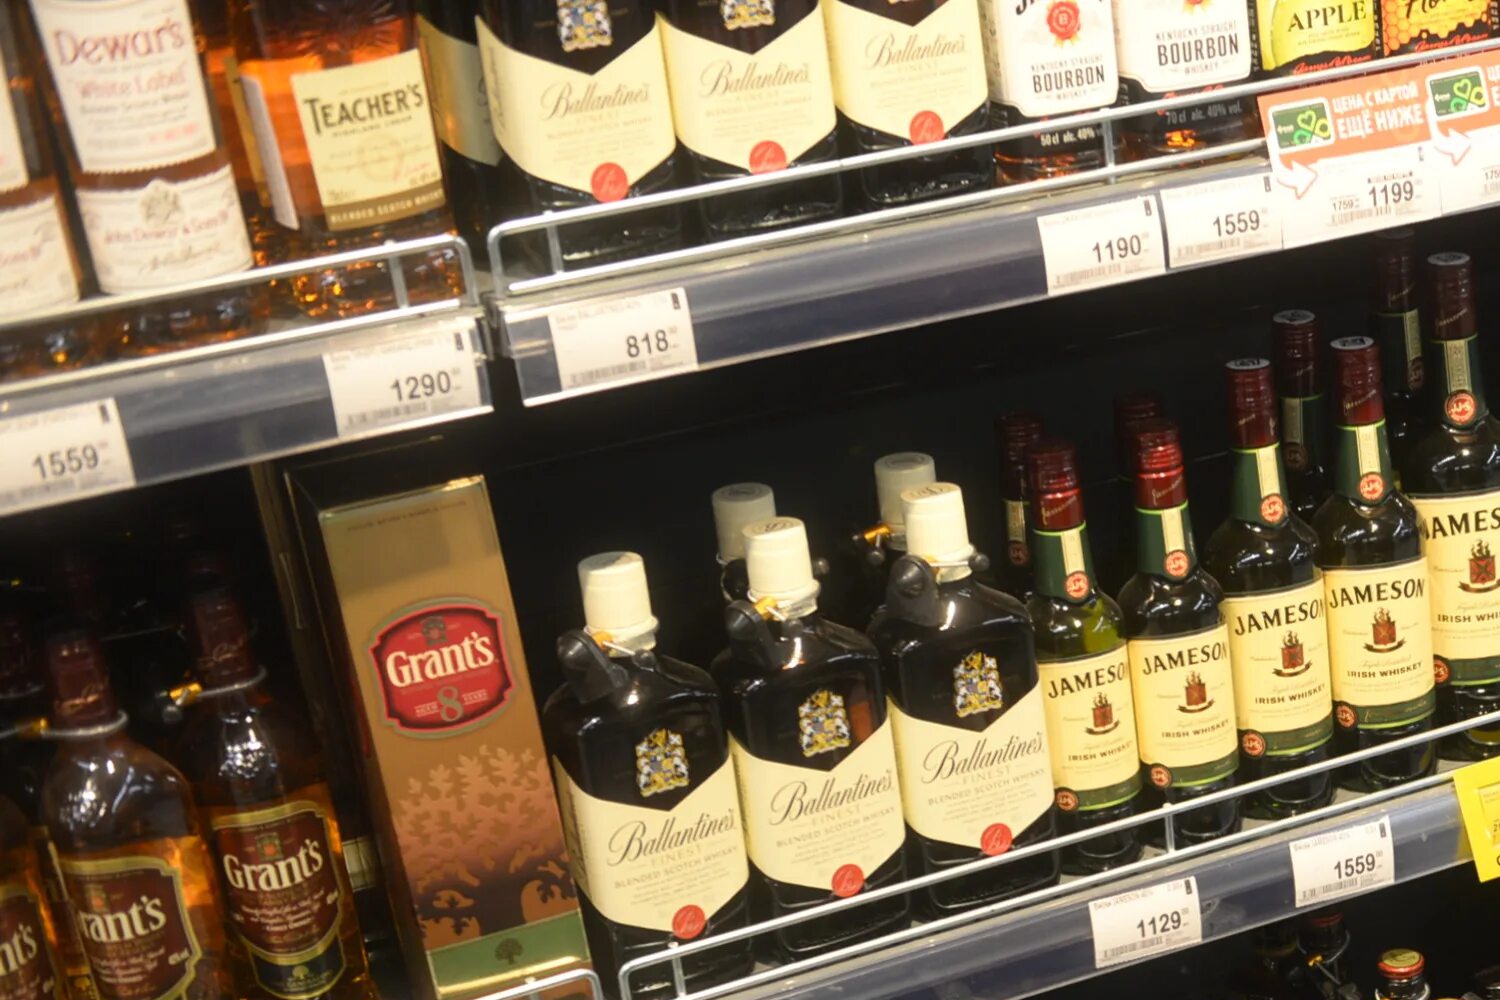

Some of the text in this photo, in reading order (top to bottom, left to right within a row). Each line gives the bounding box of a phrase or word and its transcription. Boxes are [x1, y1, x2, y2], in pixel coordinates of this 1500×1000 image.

[1287, 0, 1367, 32] APPLE
[54, 20, 184, 65] Dewar's
[864, 33, 966, 70] Ballantine's
[1157, 33, 1240, 66] BOURBON
[700, 59, 811, 98] Ballantine's
[1032, 65, 1105, 93] BOURBON
[1184, 62, 1220, 76] WHISKEY
[304, 82, 424, 137] TEACHER'S
[541, 82, 650, 121] Ballantine's
[1207, 102, 1226, 118] 40%
[1331, 81, 1420, 114] ЦЕНА С КАРТОЙ
[1336, 103, 1424, 139] ЕЩЁ НИЖЕ
[1369, 180, 1414, 207] 1199
[1213, 210, 1260, 237] 1559
[1093, 234, 1142, 262] 1190
[626, 329, 669, 358] 818
[391, 371, 452, 402] 1290
[32, 443, 99, 480] 1559
[1329, 578, 1425, 610] JAMESON
[1234, 598, 1325, 636] JAMESON
[1437, 613, 1472, 624] IRISH
[386, 631, 495, 688] Grant's
[1347, 669, 1377, 679] IRISH
[1379, 661, 1423, 678] WHISKEY
[1048, 661, 1129, 699] JAMESO
[1255, 682, 1326, 706] IRISH WHISKEY
[437, 686, 464, 723] 8
[1161, 730, 1190, 740] IRISH
[921, 731, 1045, 784] Ballantine's
[1068, 752, 1097, 762] IRISH
[769, 768, 894, 826] Ballantine's
[606, 807, 737, 867] Ballantine's
[223, 838, 324, 892] Grant's
[1334, 853, 1376, 879] 1559
[78, 895, 167, 943] rant's
[1136, 910, 1181, 938] 1129
